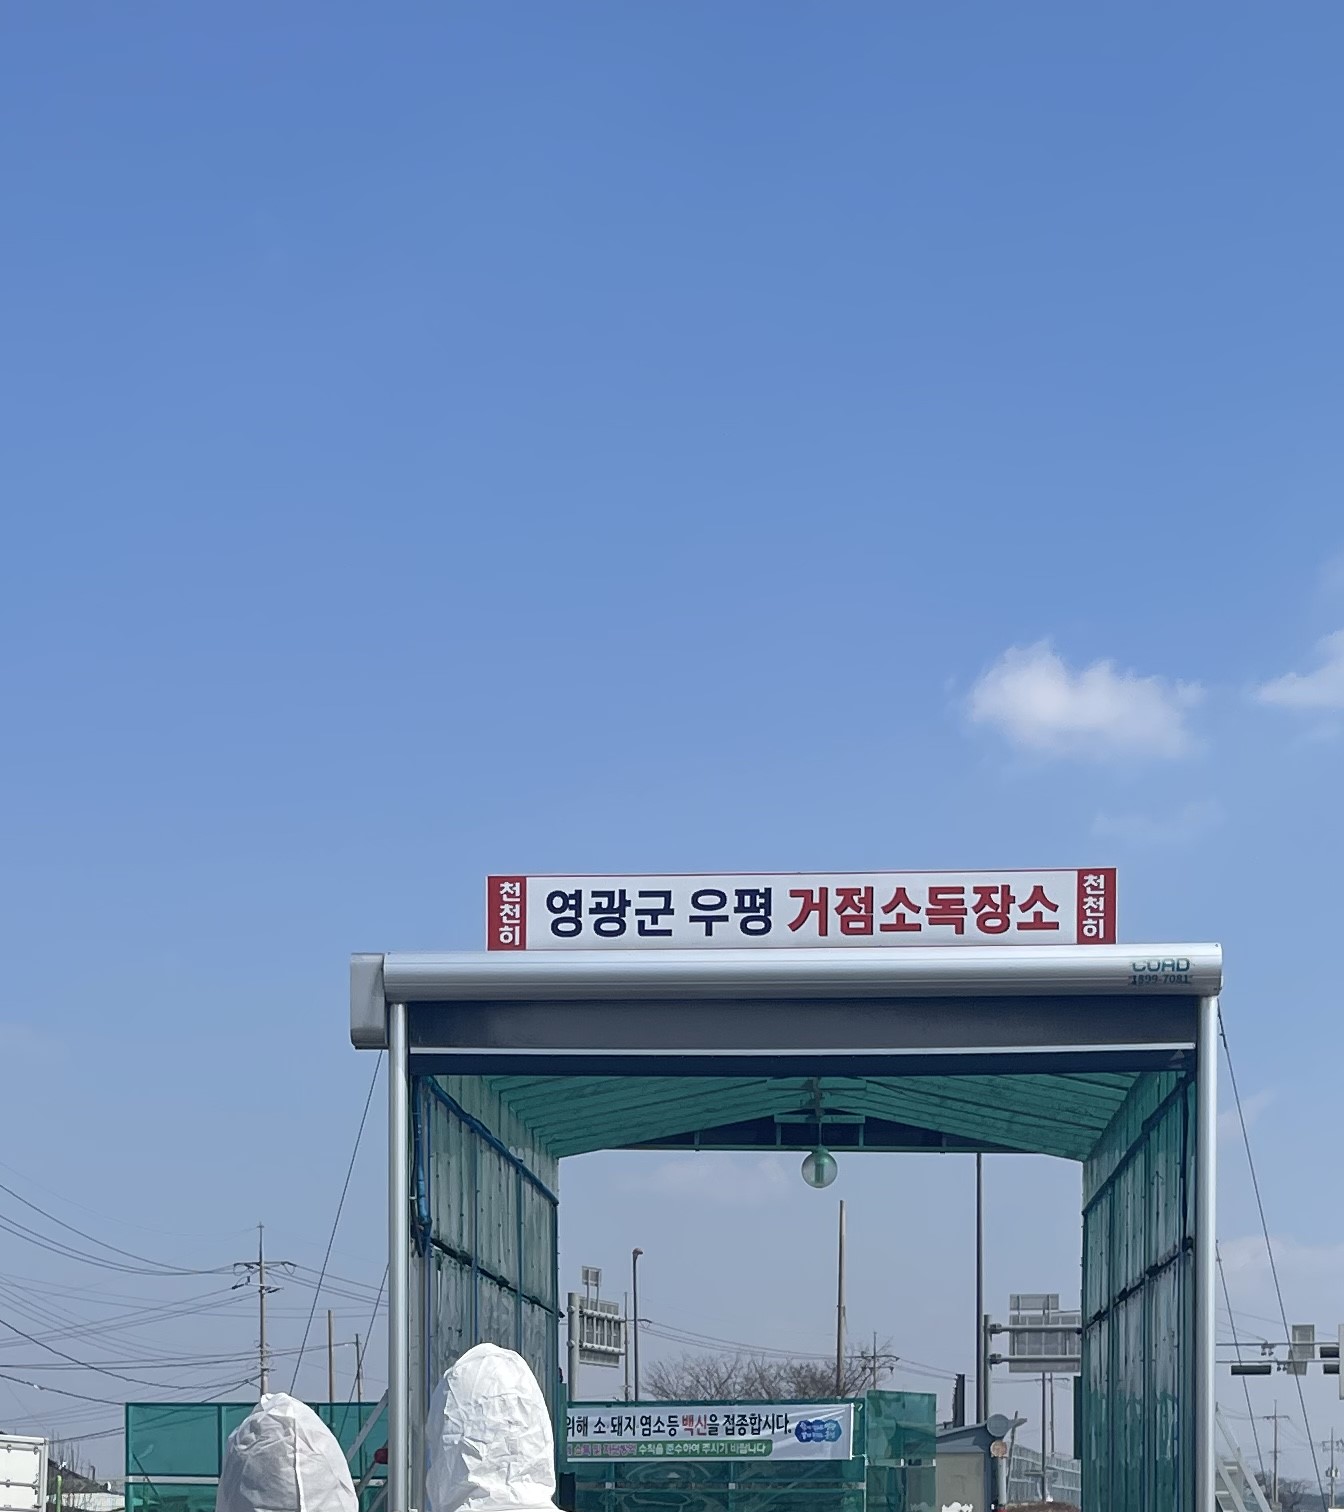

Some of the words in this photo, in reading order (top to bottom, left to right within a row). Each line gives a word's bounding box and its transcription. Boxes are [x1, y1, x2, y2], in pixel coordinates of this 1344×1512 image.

[499, 881, 521, 946] 천천히
[545, 887, 675, 938] 영광군
[688, 886, 773, 938] 우평
[787, 884, 1060, 937] 거점소독장소
[1082, 873, 1106, 940] 천천히
[681, 1413, 720, 1437] 백신을
[722, 1412, 792, 1436] 접종합시다.
